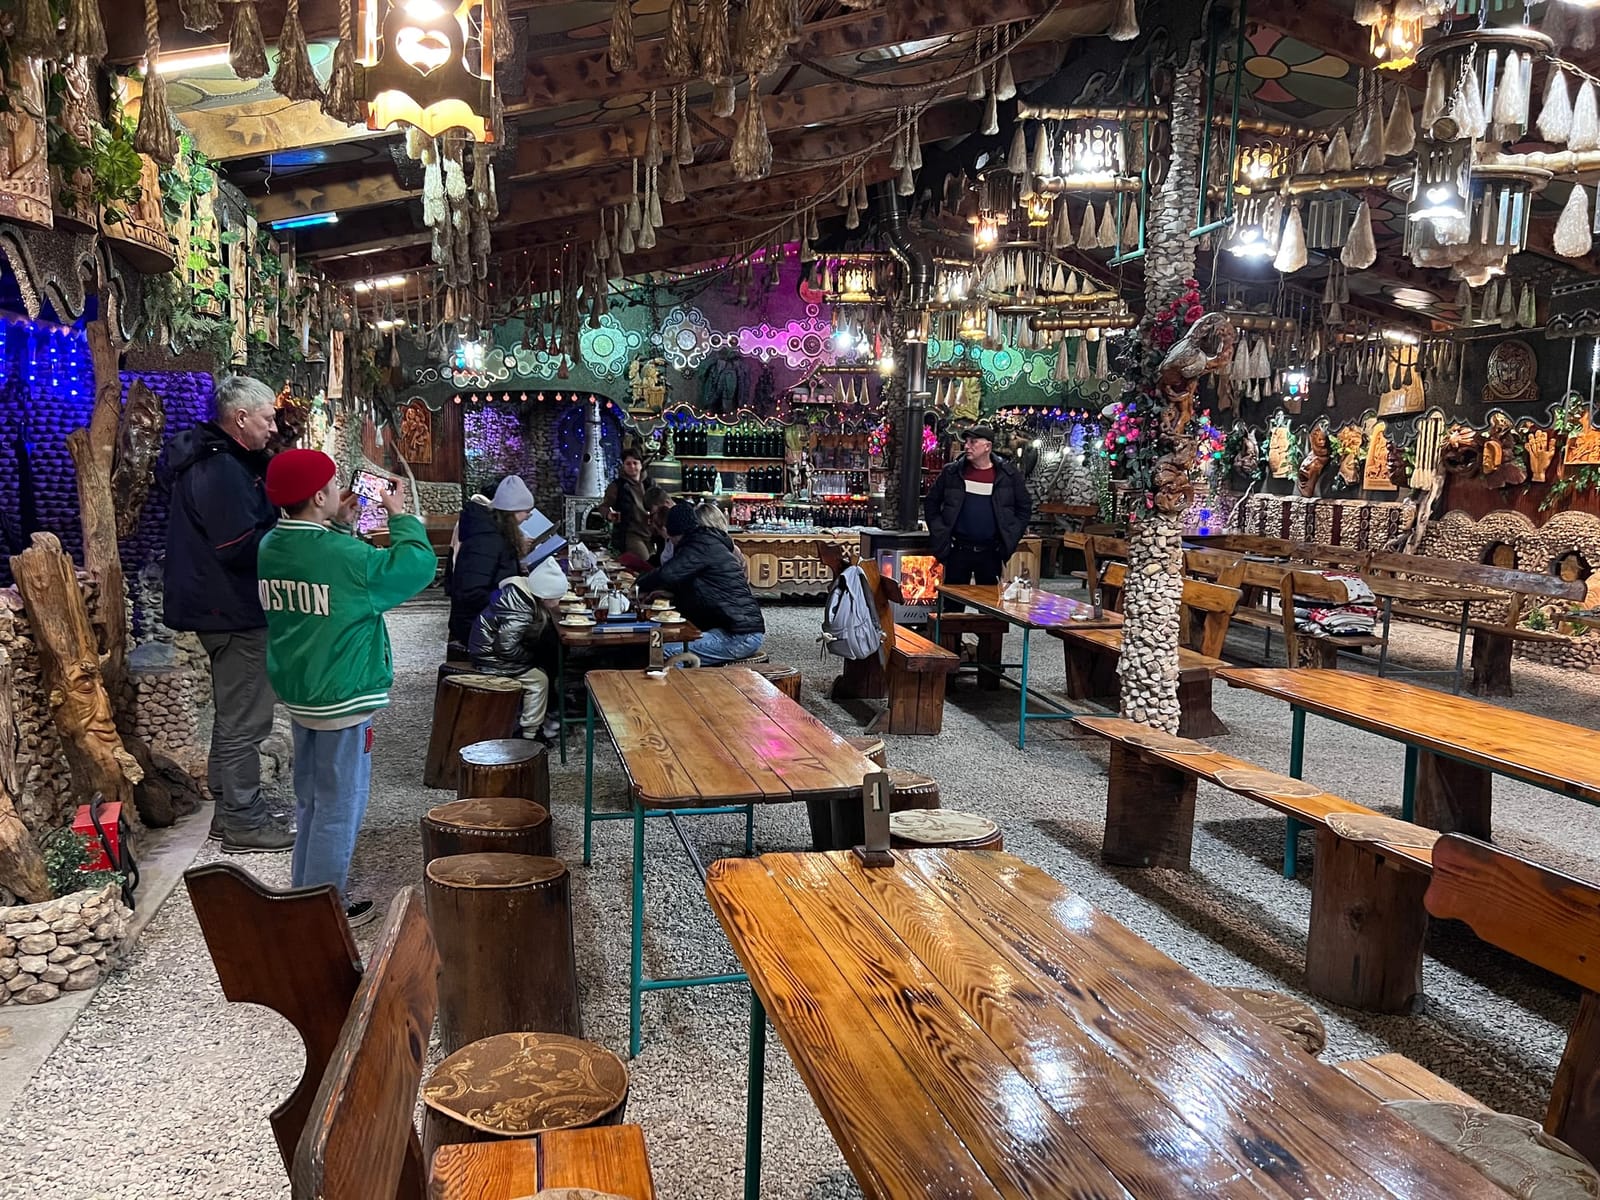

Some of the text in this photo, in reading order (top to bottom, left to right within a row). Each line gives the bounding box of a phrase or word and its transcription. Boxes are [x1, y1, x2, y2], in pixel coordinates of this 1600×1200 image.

[258, 579, 329, 616] OSTON
[651, 630, 661, 647] 2
[870, 782, 881, 810] 1
